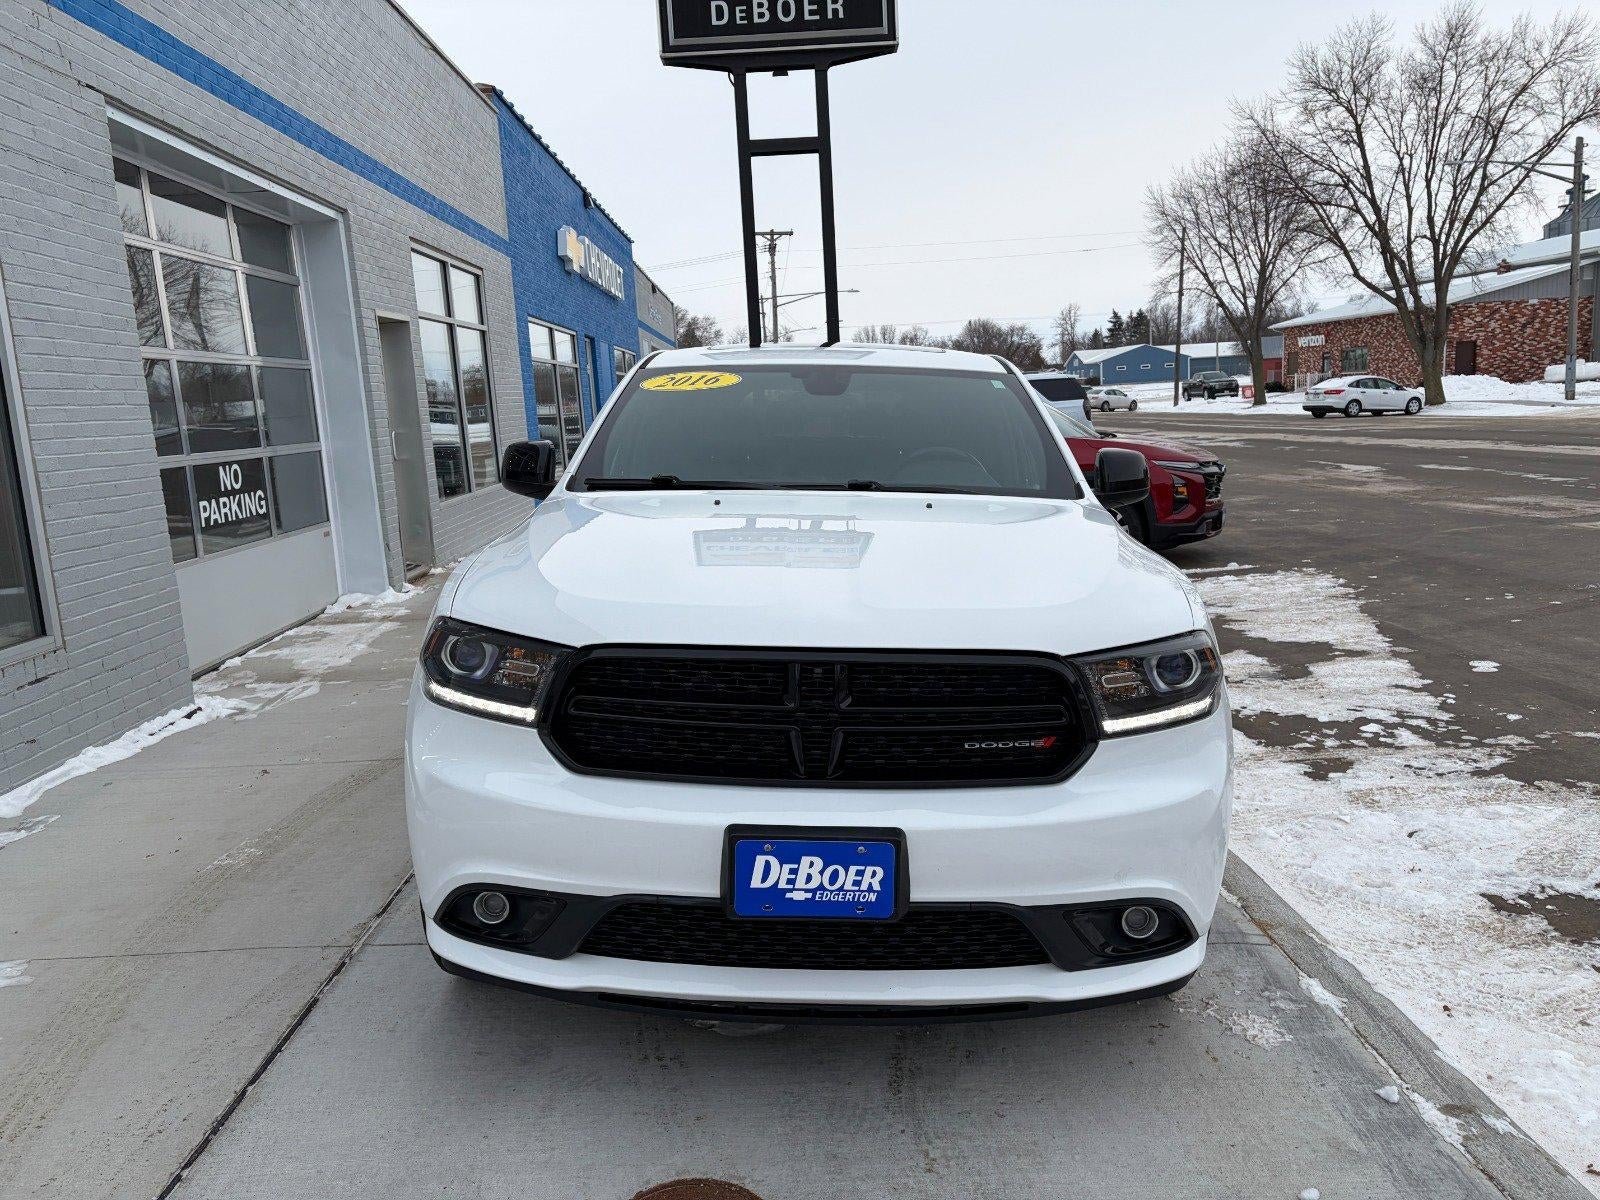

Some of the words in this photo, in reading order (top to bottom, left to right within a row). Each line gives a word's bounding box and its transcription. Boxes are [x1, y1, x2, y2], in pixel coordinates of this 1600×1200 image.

[1297, 334, 1326, 348] verizon
[652, 374, 723, 389] 2016
[218, 463, 243, 492] NO
[198, 489, 267, 528] PARKING
[964, 739, 1045, 749] DODGE
[814, 890, 878, 903] EDGERTON
